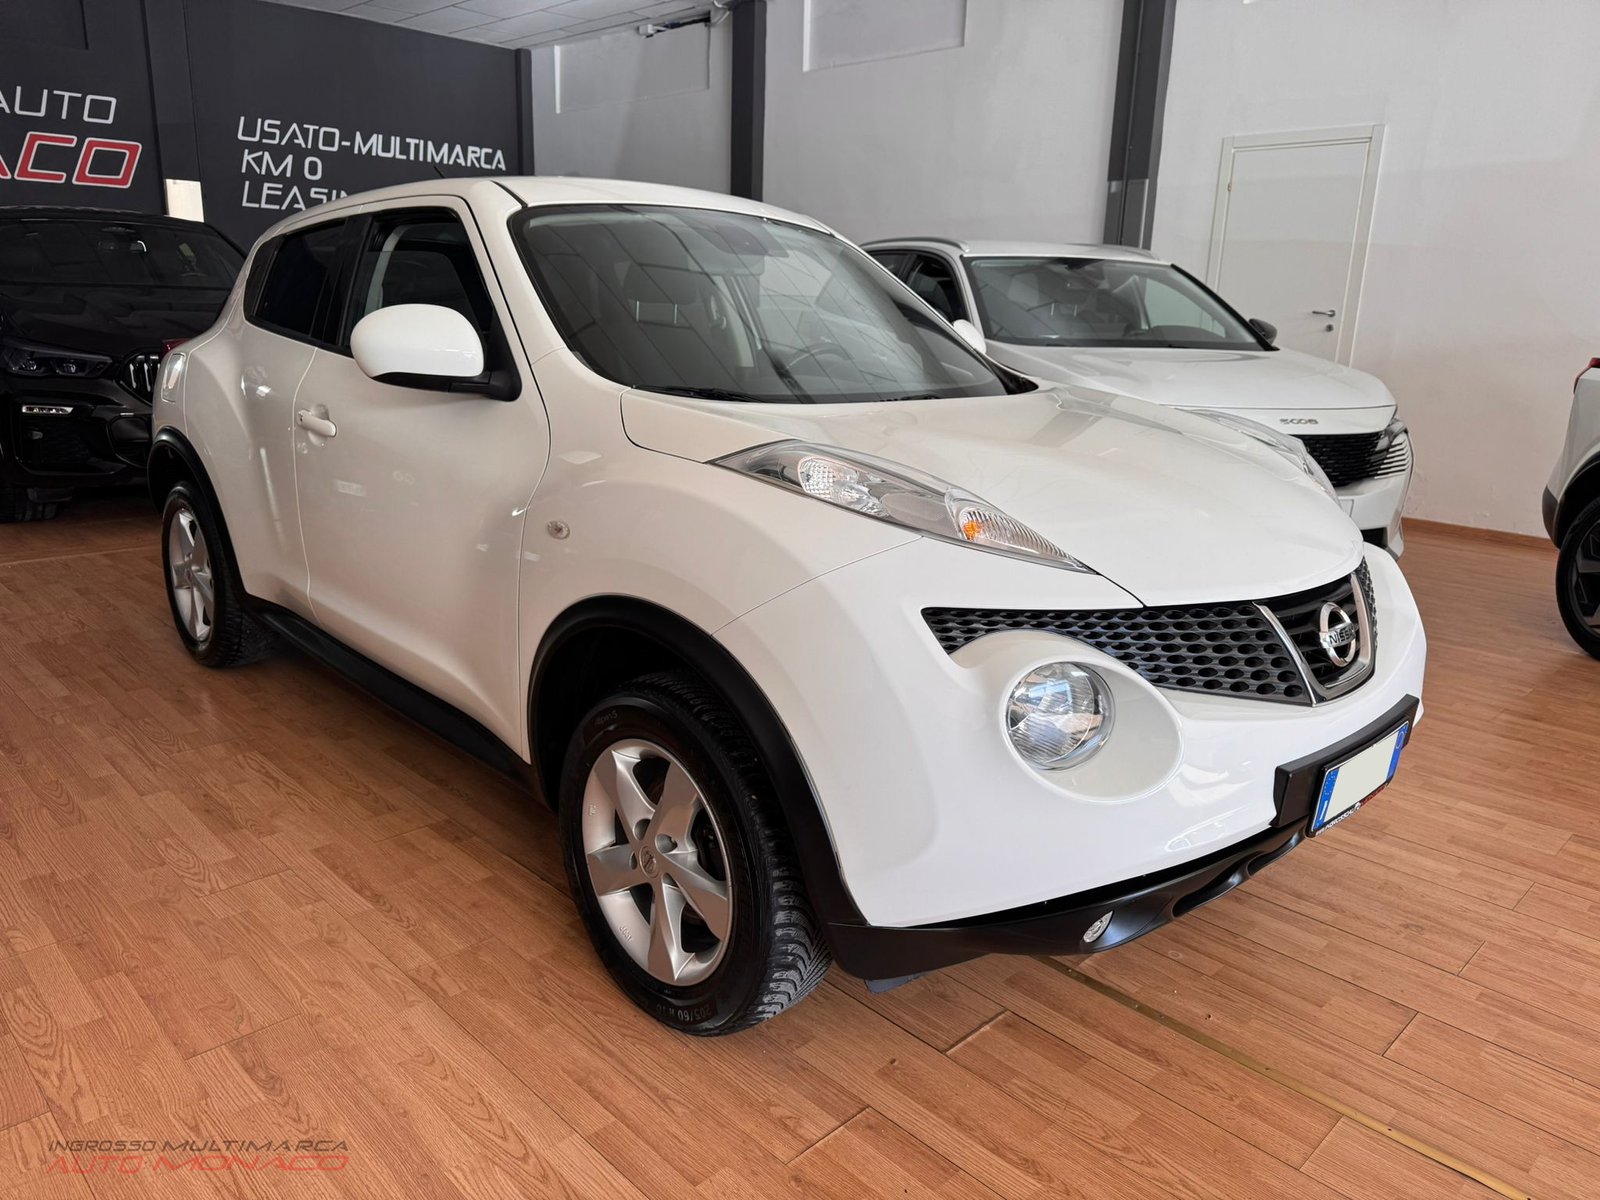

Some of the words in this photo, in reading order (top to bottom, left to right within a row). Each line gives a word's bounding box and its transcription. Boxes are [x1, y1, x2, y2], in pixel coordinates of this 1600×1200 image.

[0, 131, 142, 188] CO
[237, 116, 507, 171] USATO-MULTIMARCA
[241, 149, 293, 178] KM
